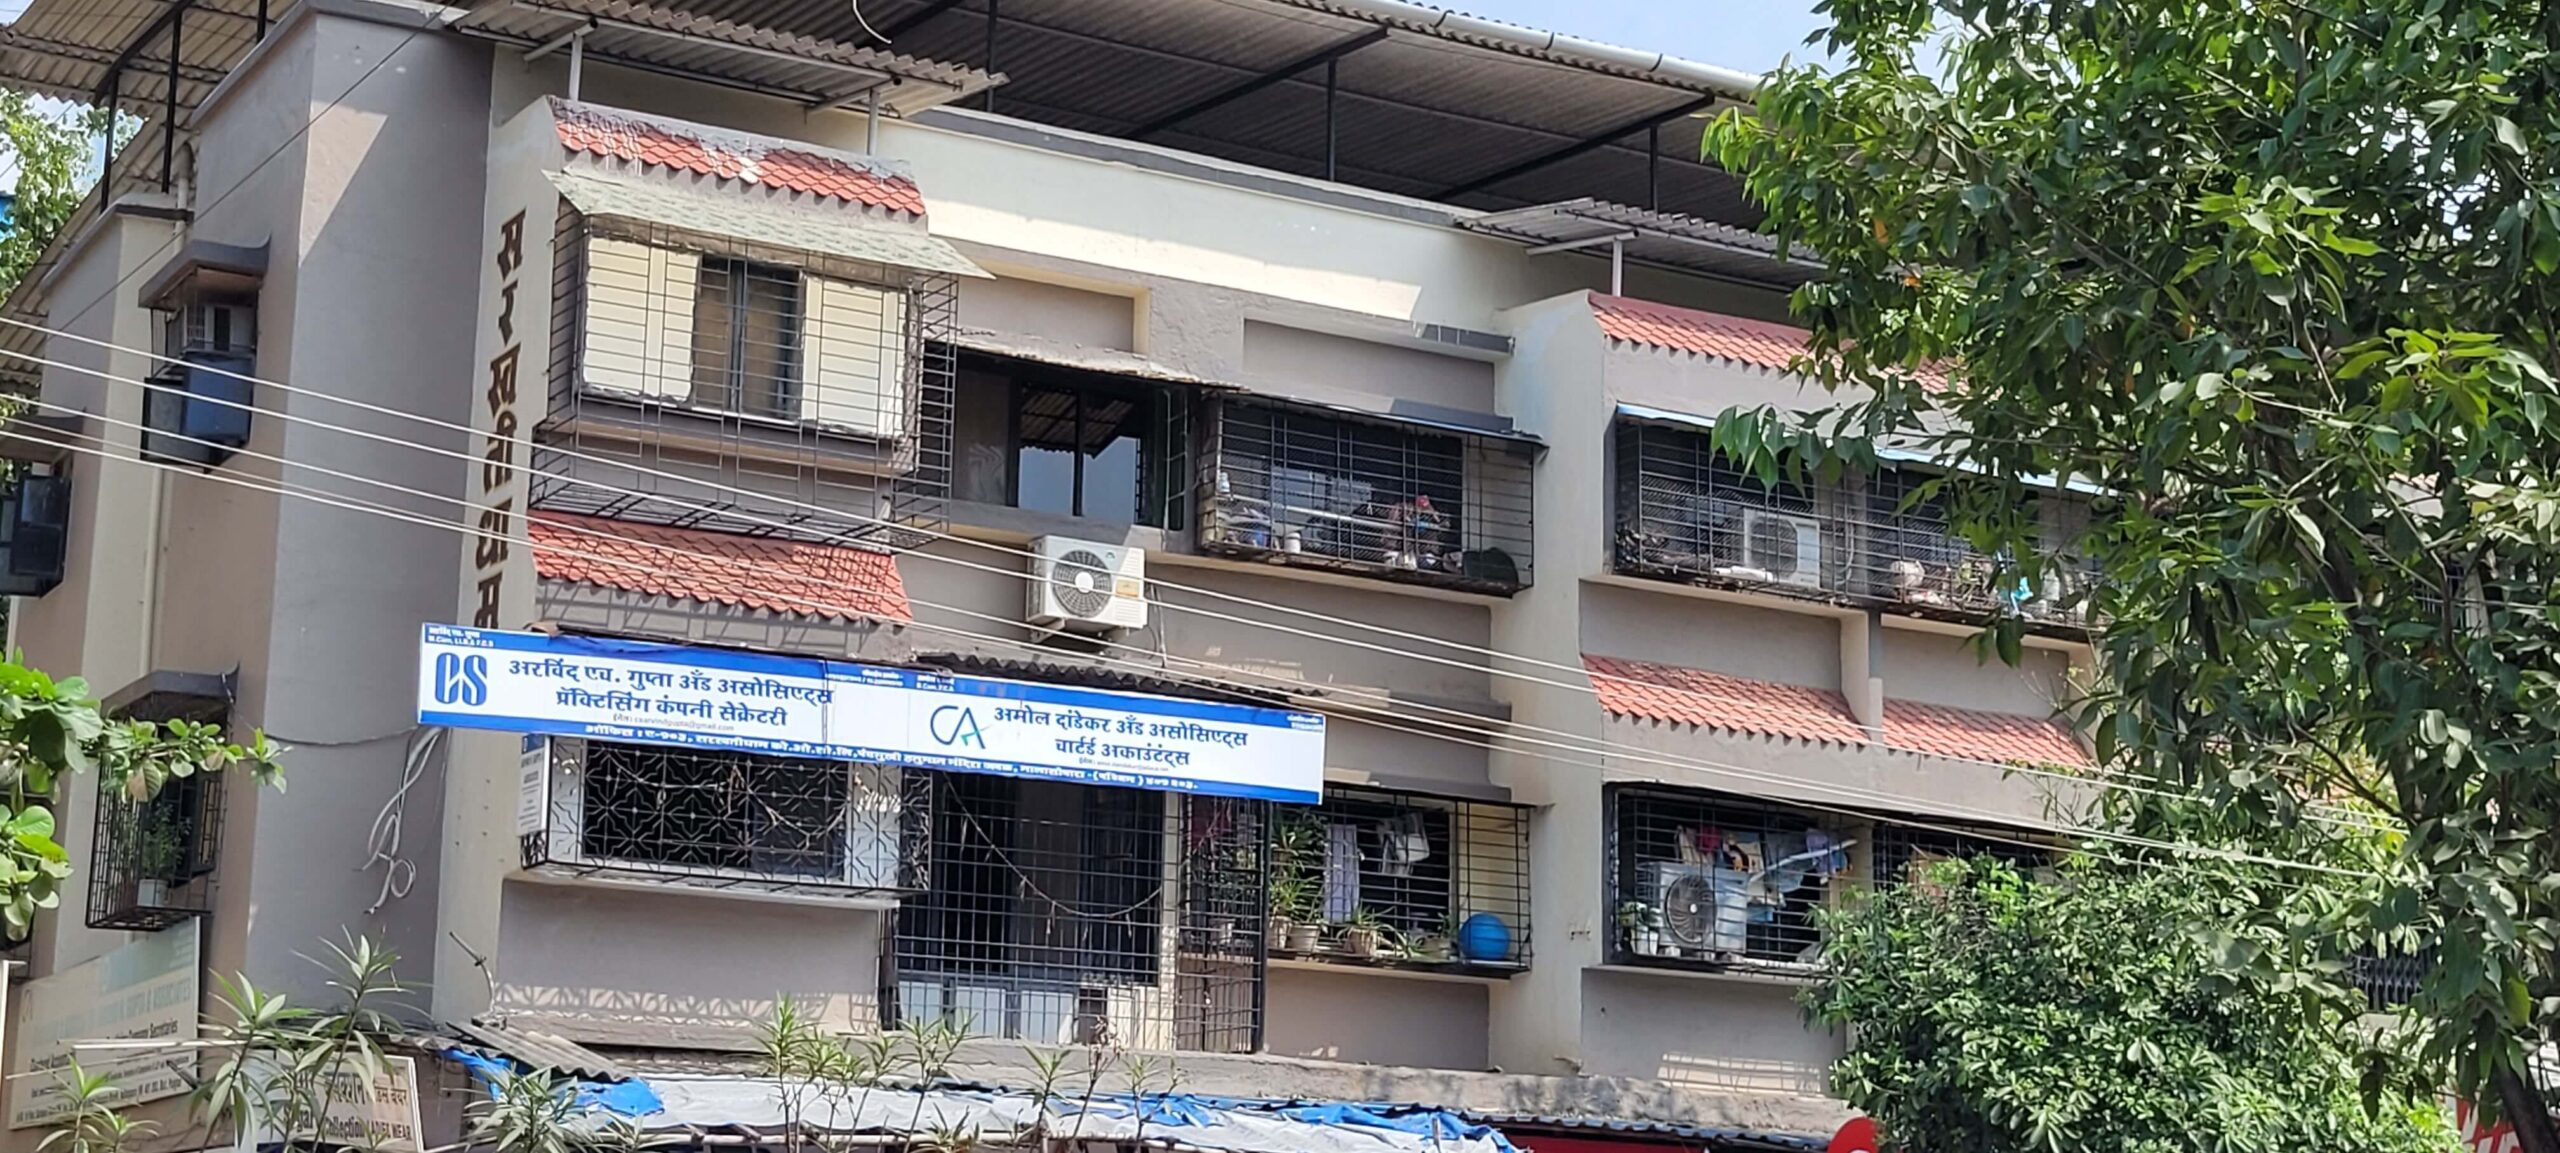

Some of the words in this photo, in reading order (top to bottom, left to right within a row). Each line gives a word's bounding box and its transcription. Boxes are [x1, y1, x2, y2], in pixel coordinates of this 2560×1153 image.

[434, 652, 488, 706] CS
[509, 658, 580, 683] अरविंद
[627, 669, 674, 691] गुप्ता
[679, 669, 712, 692] अँड
[718, 676, 834, 707] असोसिएट्स
[655, 694, 713, 719] कंपनी
[719, 700, 788, 726] सेक्रेटरी
[994, 704, 1051, 726] अमोल
[1055, 709, 1112, 732] दांडेकर
[1116, 714, 1144, 736] अँड
[1149, 720, 1248, 748] असोसिएट्स
[1055, 735, 1097, 756] चार्टर्ड
[1101, 742, 1190, 768] अकाउंटंट्स
